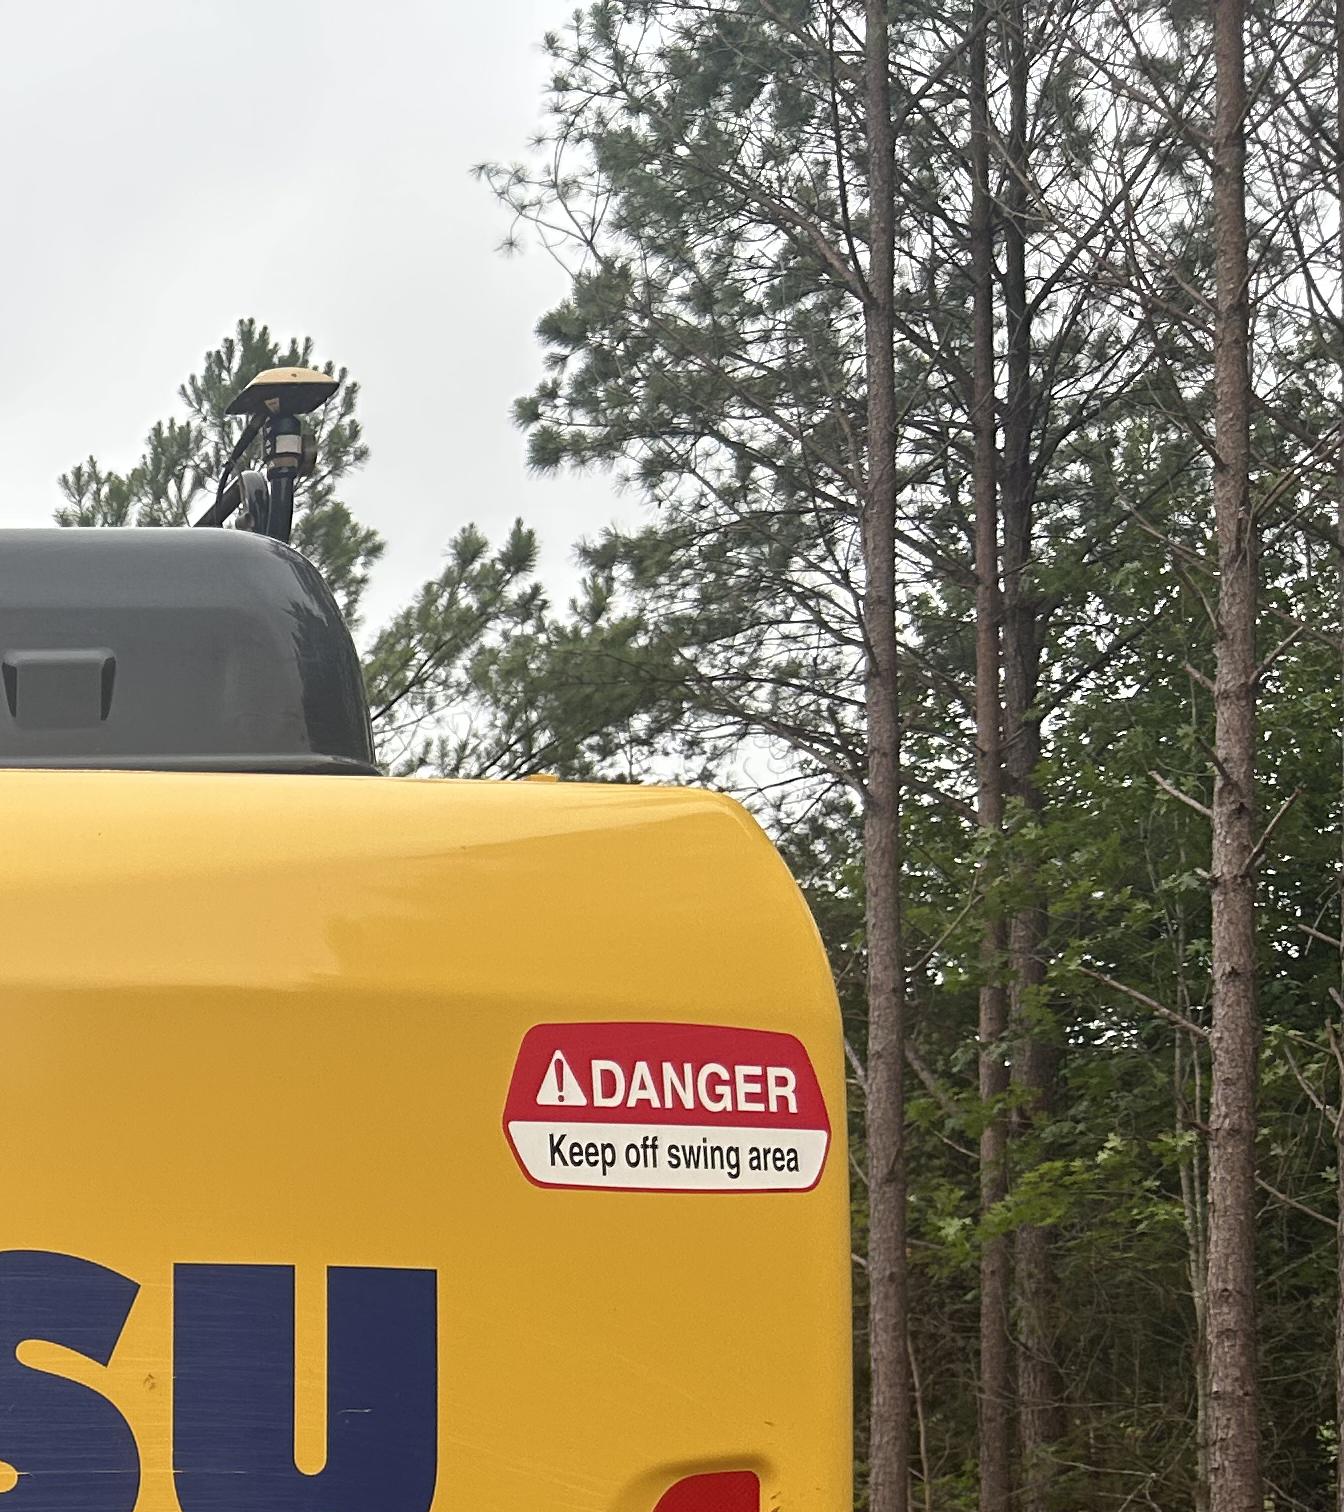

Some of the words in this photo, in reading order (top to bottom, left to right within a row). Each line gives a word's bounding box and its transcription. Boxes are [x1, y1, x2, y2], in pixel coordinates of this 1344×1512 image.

[591, 1059, 798, 1114] DANGER
[548, 1133, 617, 1176] Keep
[625, 1135, 659, 1169] off
[667, 1137, 741, 1179] swing
[748, 1145, 800, 1173] area
